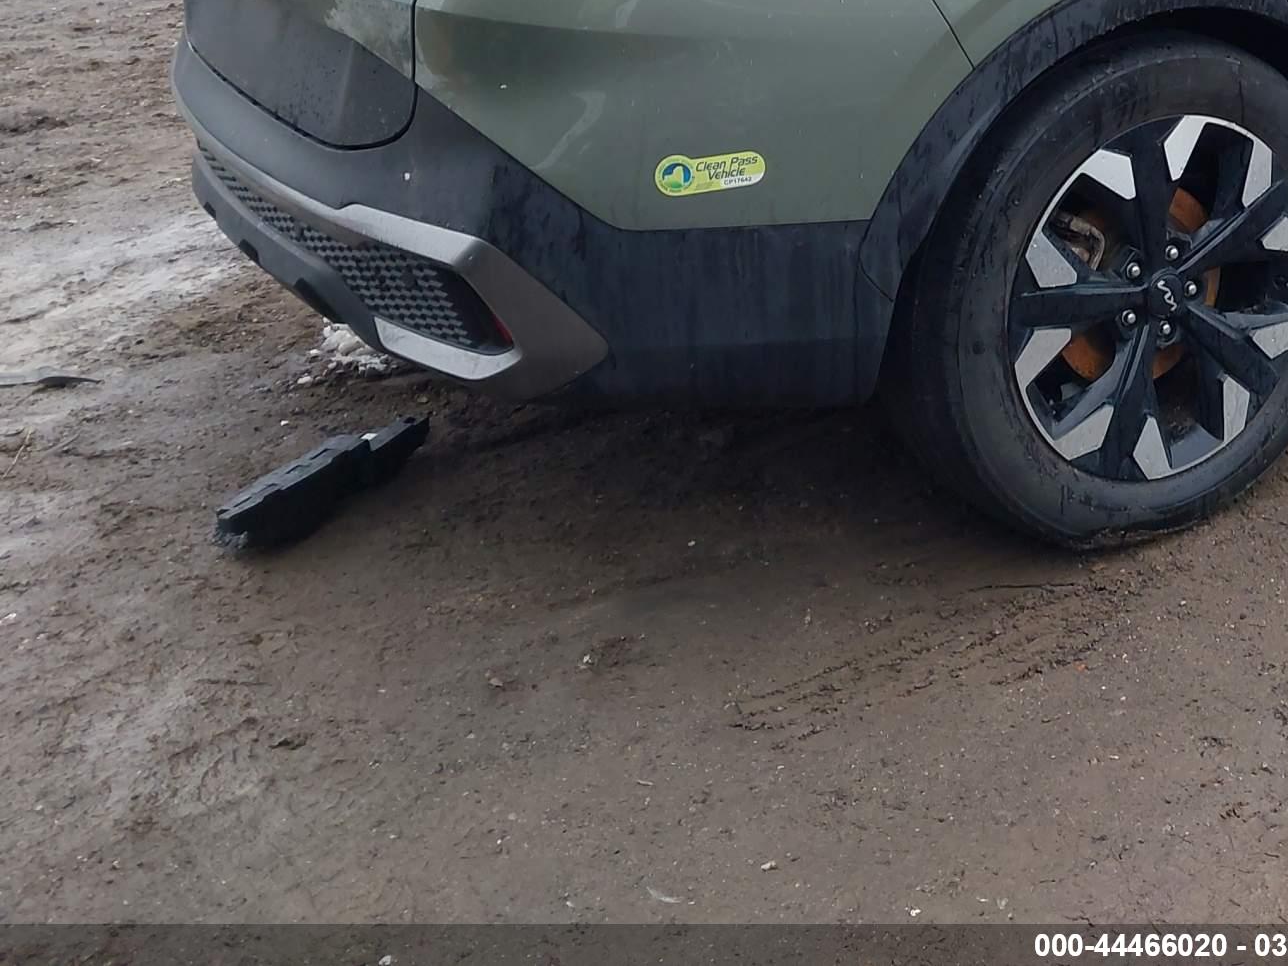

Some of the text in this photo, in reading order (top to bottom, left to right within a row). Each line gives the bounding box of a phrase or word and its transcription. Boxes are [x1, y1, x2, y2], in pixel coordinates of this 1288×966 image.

[695, 156, 759, 172] Clean Pass
[708, 166, 746, 180] Vehicle
